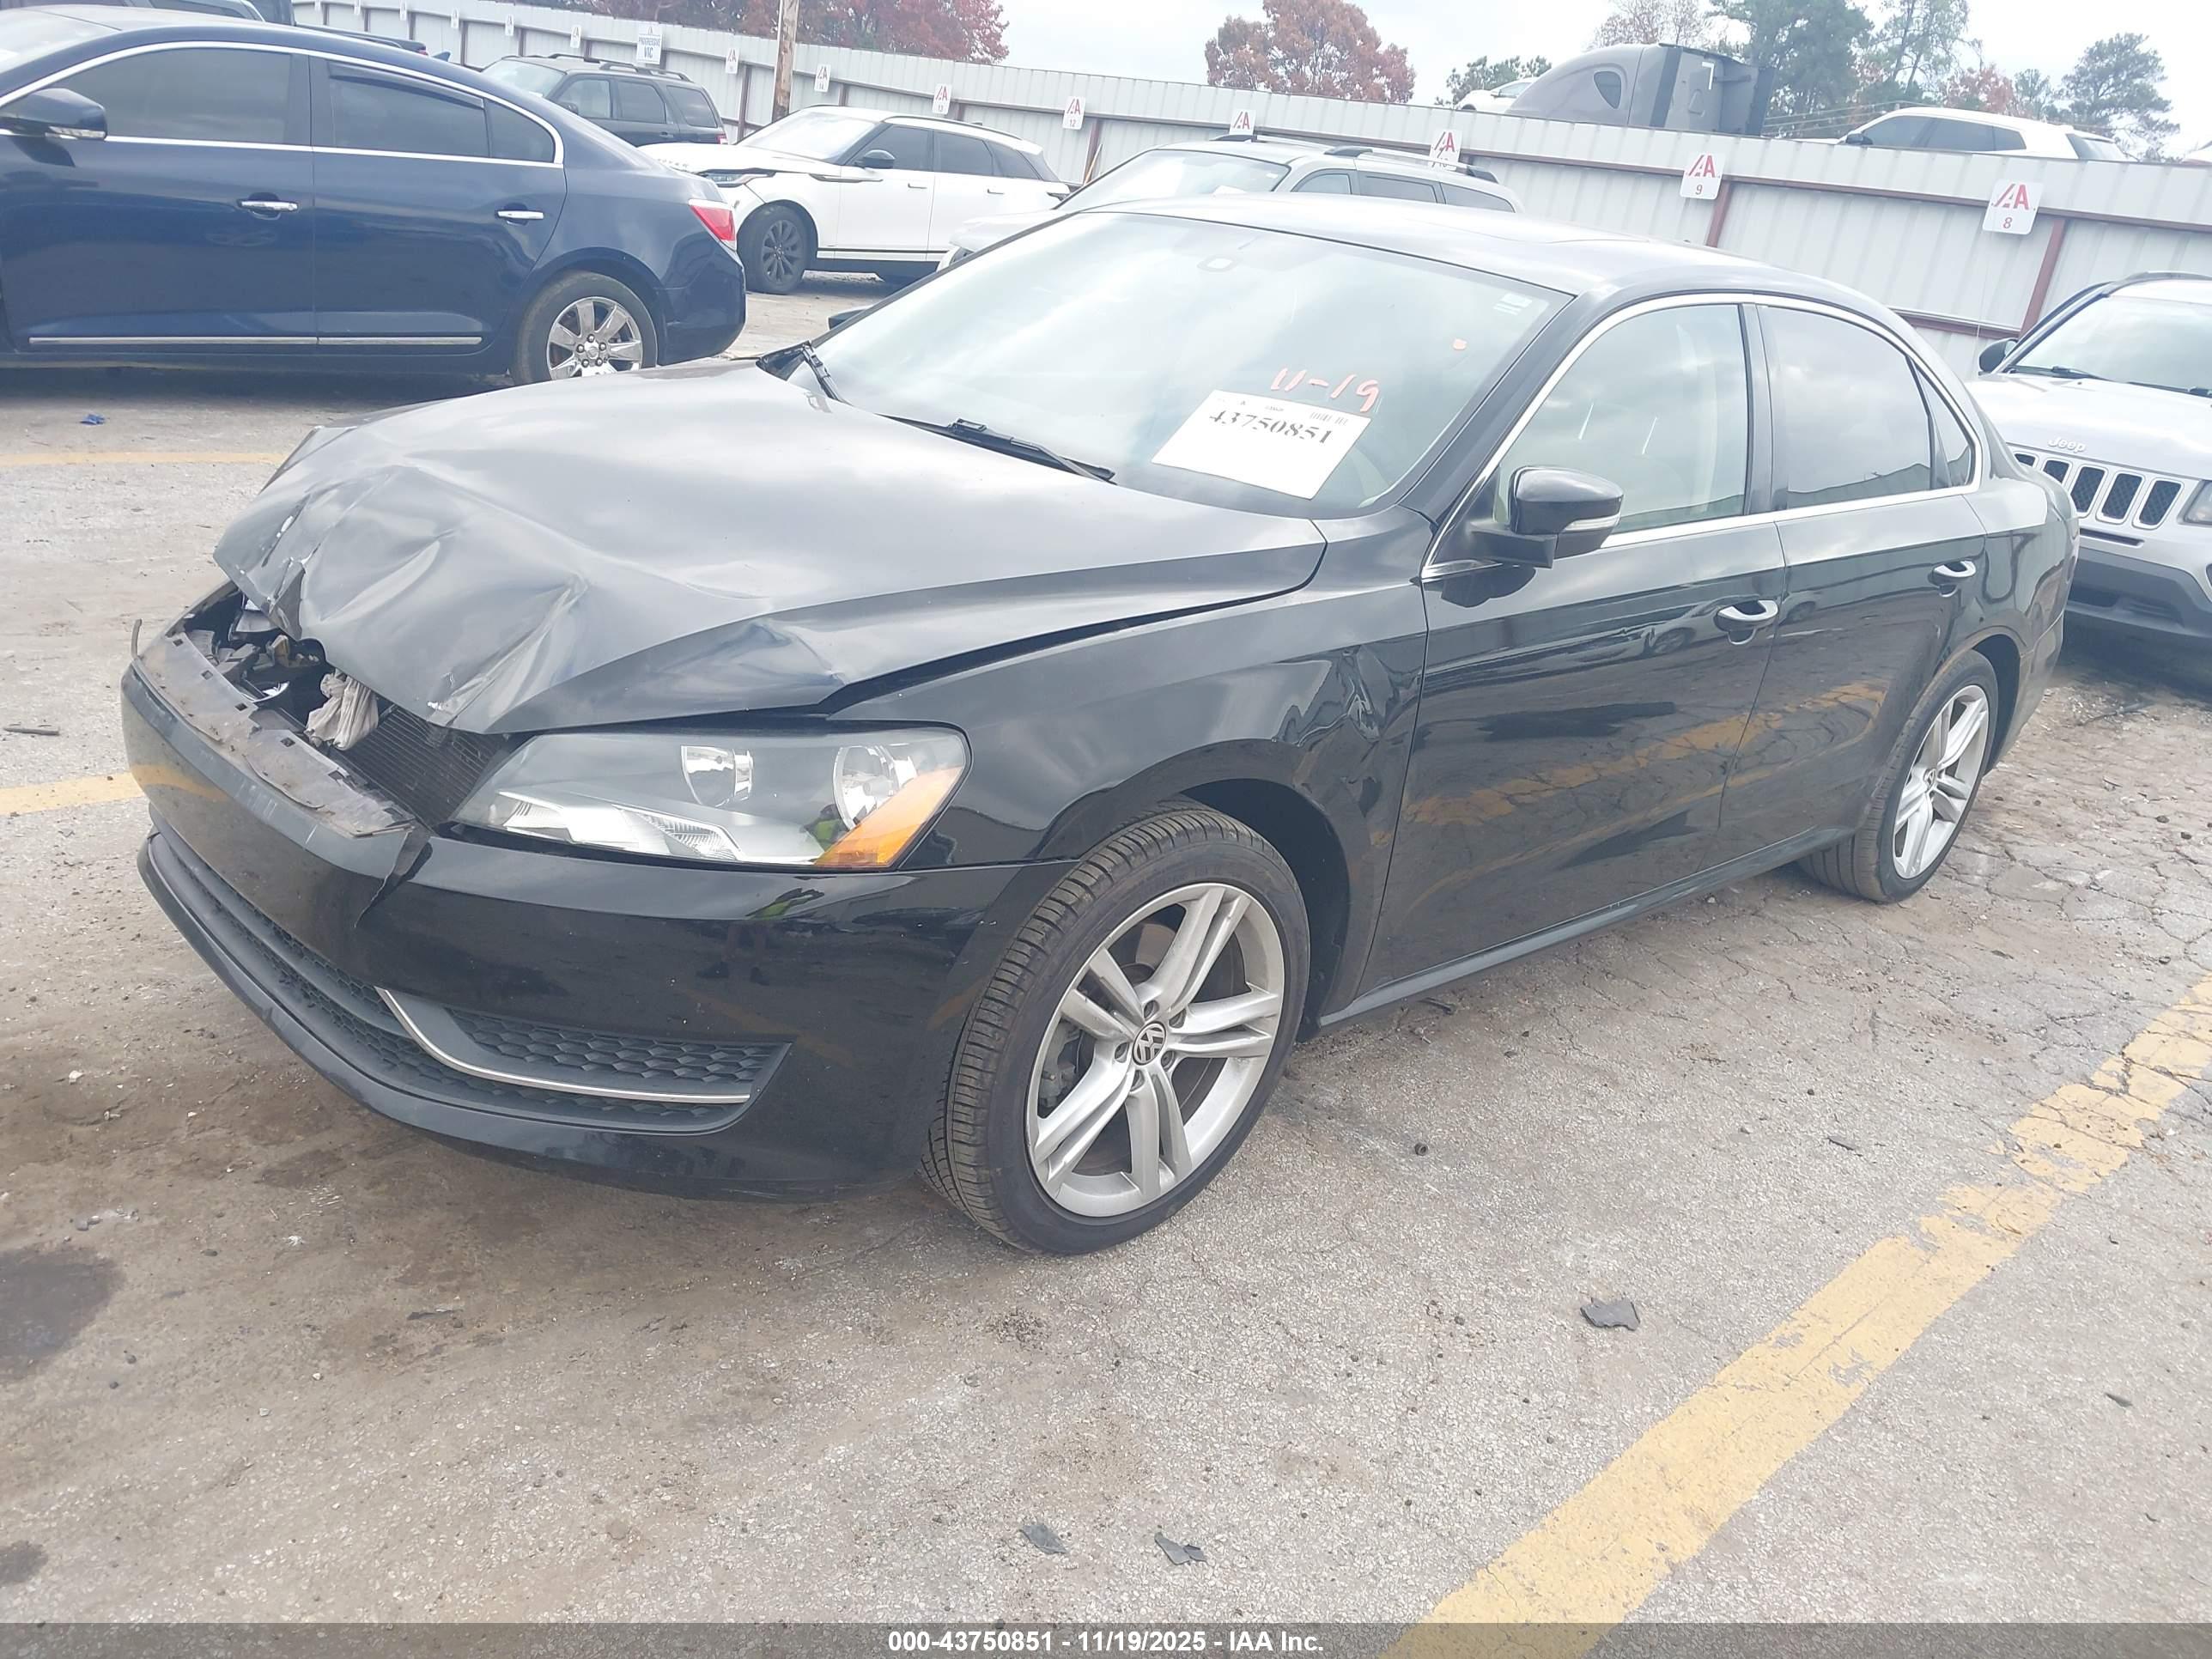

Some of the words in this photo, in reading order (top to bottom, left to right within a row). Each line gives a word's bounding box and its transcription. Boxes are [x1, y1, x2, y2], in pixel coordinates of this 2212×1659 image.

[1695, 183, 1704, 196] 9
[2002, 216, 2013, 229] 8
[1208, 409, 1333, 445] 43750851
[2047, 436, 2087, 453] Jeep
